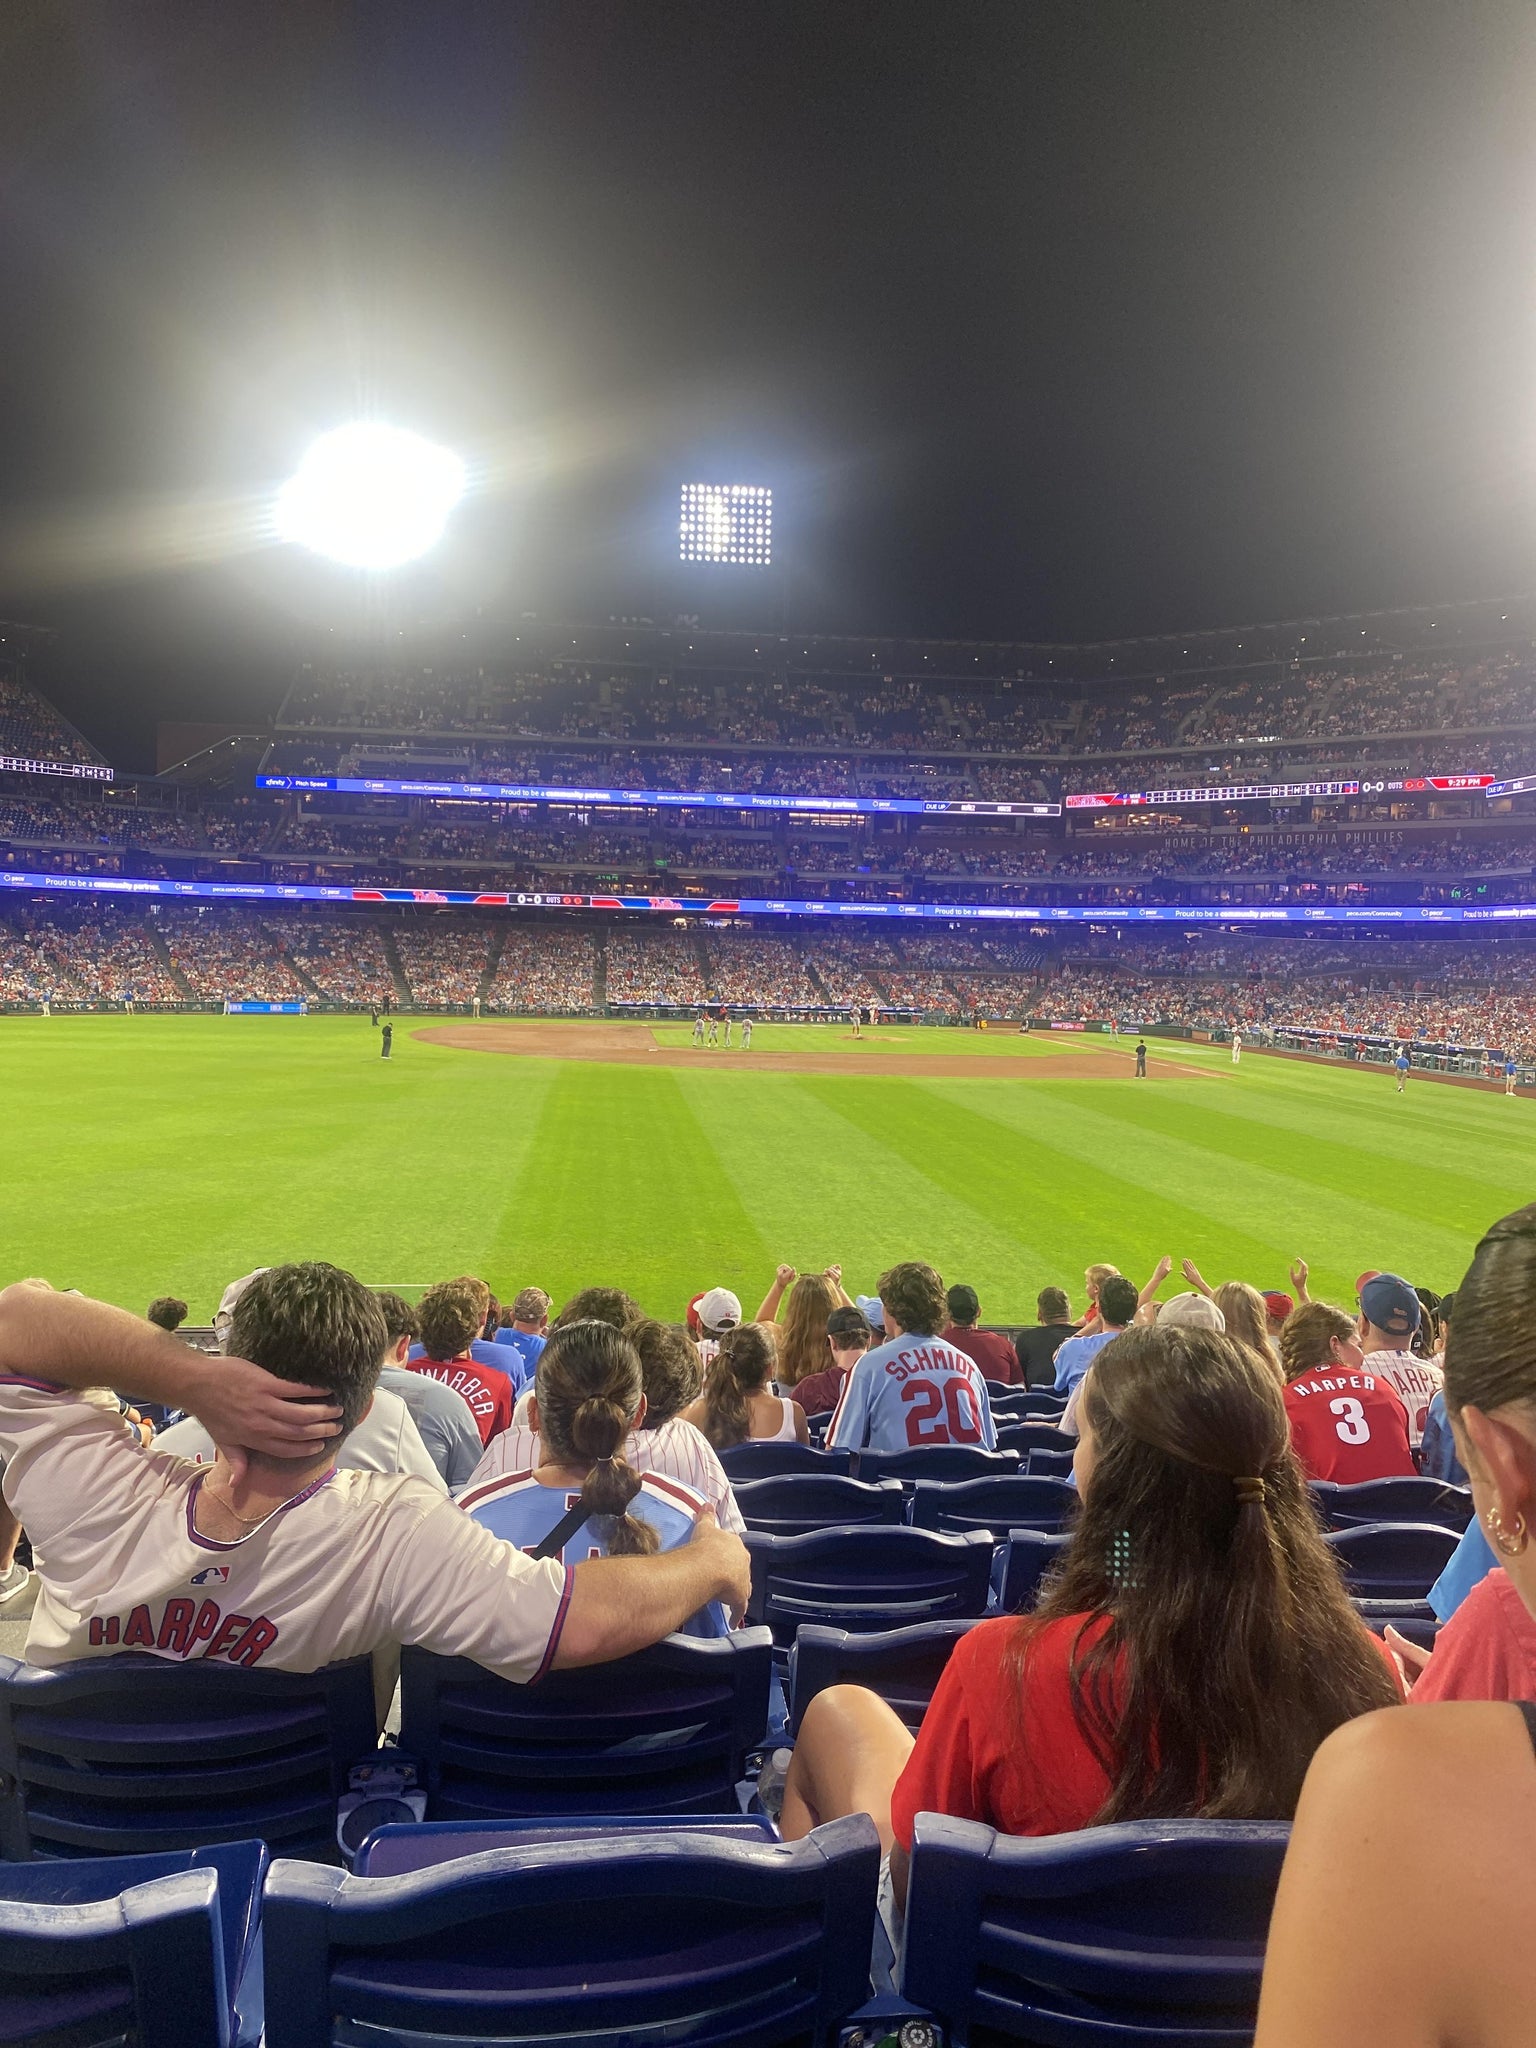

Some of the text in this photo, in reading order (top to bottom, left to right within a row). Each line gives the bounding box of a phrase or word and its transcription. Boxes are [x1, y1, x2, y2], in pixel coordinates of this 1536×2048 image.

[1362, 781, 1385, 792] 0-0
[1387, 781, 1403, 789] OUTS
[1448, 778, 1480, 787] 9:29 PM
[401, 785, 451, 793] peco.com/Community
[500, 788, 522, 796] Proud
[546, 791, 584, 800] community
[584, 792, 611, 801] partner.
[1272, 787, 1279, 796] R
[1293, 786, 1301, 794] H
[1315, 785, 1322, 793] E
[752, 797, 773, 806] Proud
[773, 798, 780, 806] to
[780, 798, 790, 806] be
[796, 800, 832, 808] community
[1165, 832, 1404, 849] HOME OF THE PHILADELPHIA PHILLIES
[45, 877, 67, 886] Proud
[68, 879, 77, 887] to
[77, 879, 87, 887] be
[94, 881, 133, 890] community
[133, 883, 161, 891] partner.
[212, 886, 265, 894] peco.com/Community
[413, 889, 448, 903] Phillies
[517, 894, 541, 904] 0-0
[546, 896, 561, 904] OUTS
[839, 905, 888, 913] peco.com/Community
[977, 910, 1014, 918] community
[1312, 909, 1325, 917] peco
[1346, 910, 1403, 918] peco.com/Community
[1463, 910, 1478, 918] Proud
[1483, 910, 1489, 918] be
[1219, 911, 1259, 919] community
[885, 1348, 976, 1382] SCHMIDT
[1293, 1375, 1376, 1397] HARPER
[419, 1368, 494, 1416] WARBER
[901, 1377, 982, 1447] 20
[1329, 1397, 1371, 1445] 3
[89, 1598, 279, 1667] HARPER
